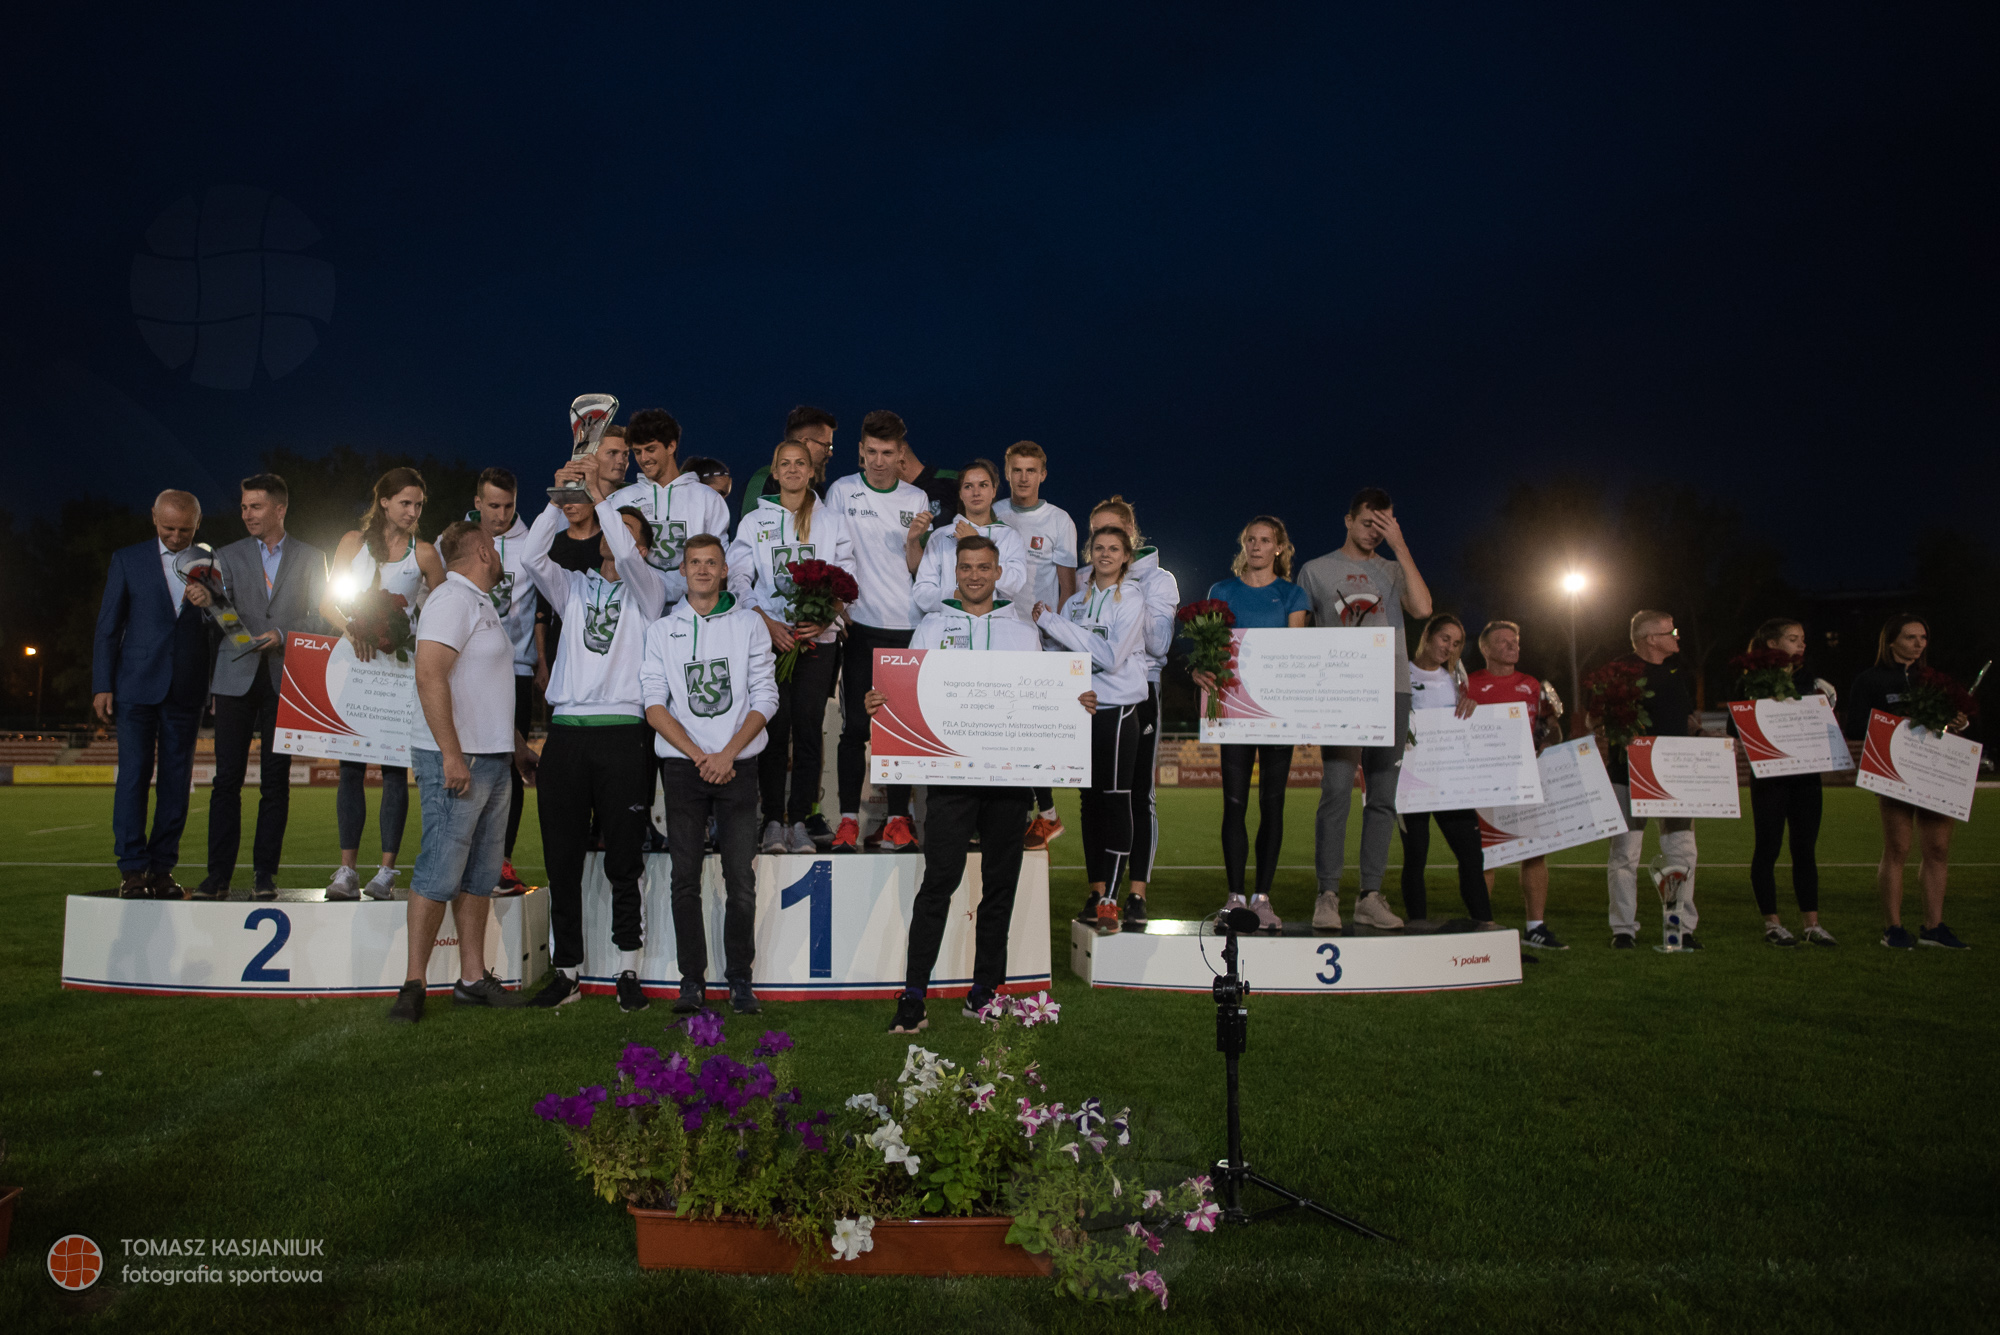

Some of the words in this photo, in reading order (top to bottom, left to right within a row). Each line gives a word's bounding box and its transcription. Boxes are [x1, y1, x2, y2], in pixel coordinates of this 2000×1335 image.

[294, 638, 330, 651] PZLA
[880, 655, 920, 666] PZLA
[351, 667, 380, 676] Nagroda
[968, 689, 988, 698] AZS
[994, 690, 1015, 698] UMCS
[1020, 690, 1048, 699] LUBLIN
[970, 702, 995, 711] zajęcie
[960, 721, 1007, 729] Drużynowych
[1874, 714, 1896, 726] PZLA
[1006, 730, 1016, 739] Ligi
[1018, 730, 1076, 740] Lekkoatletycznej
[317, 770, 340, 780] PZL
[781, 860, 832, 978] 1
[241, 908, 292, 982] 2
[1316, 942, 1342, 984] 3
[1460, 954, 1491, 967] polanik
